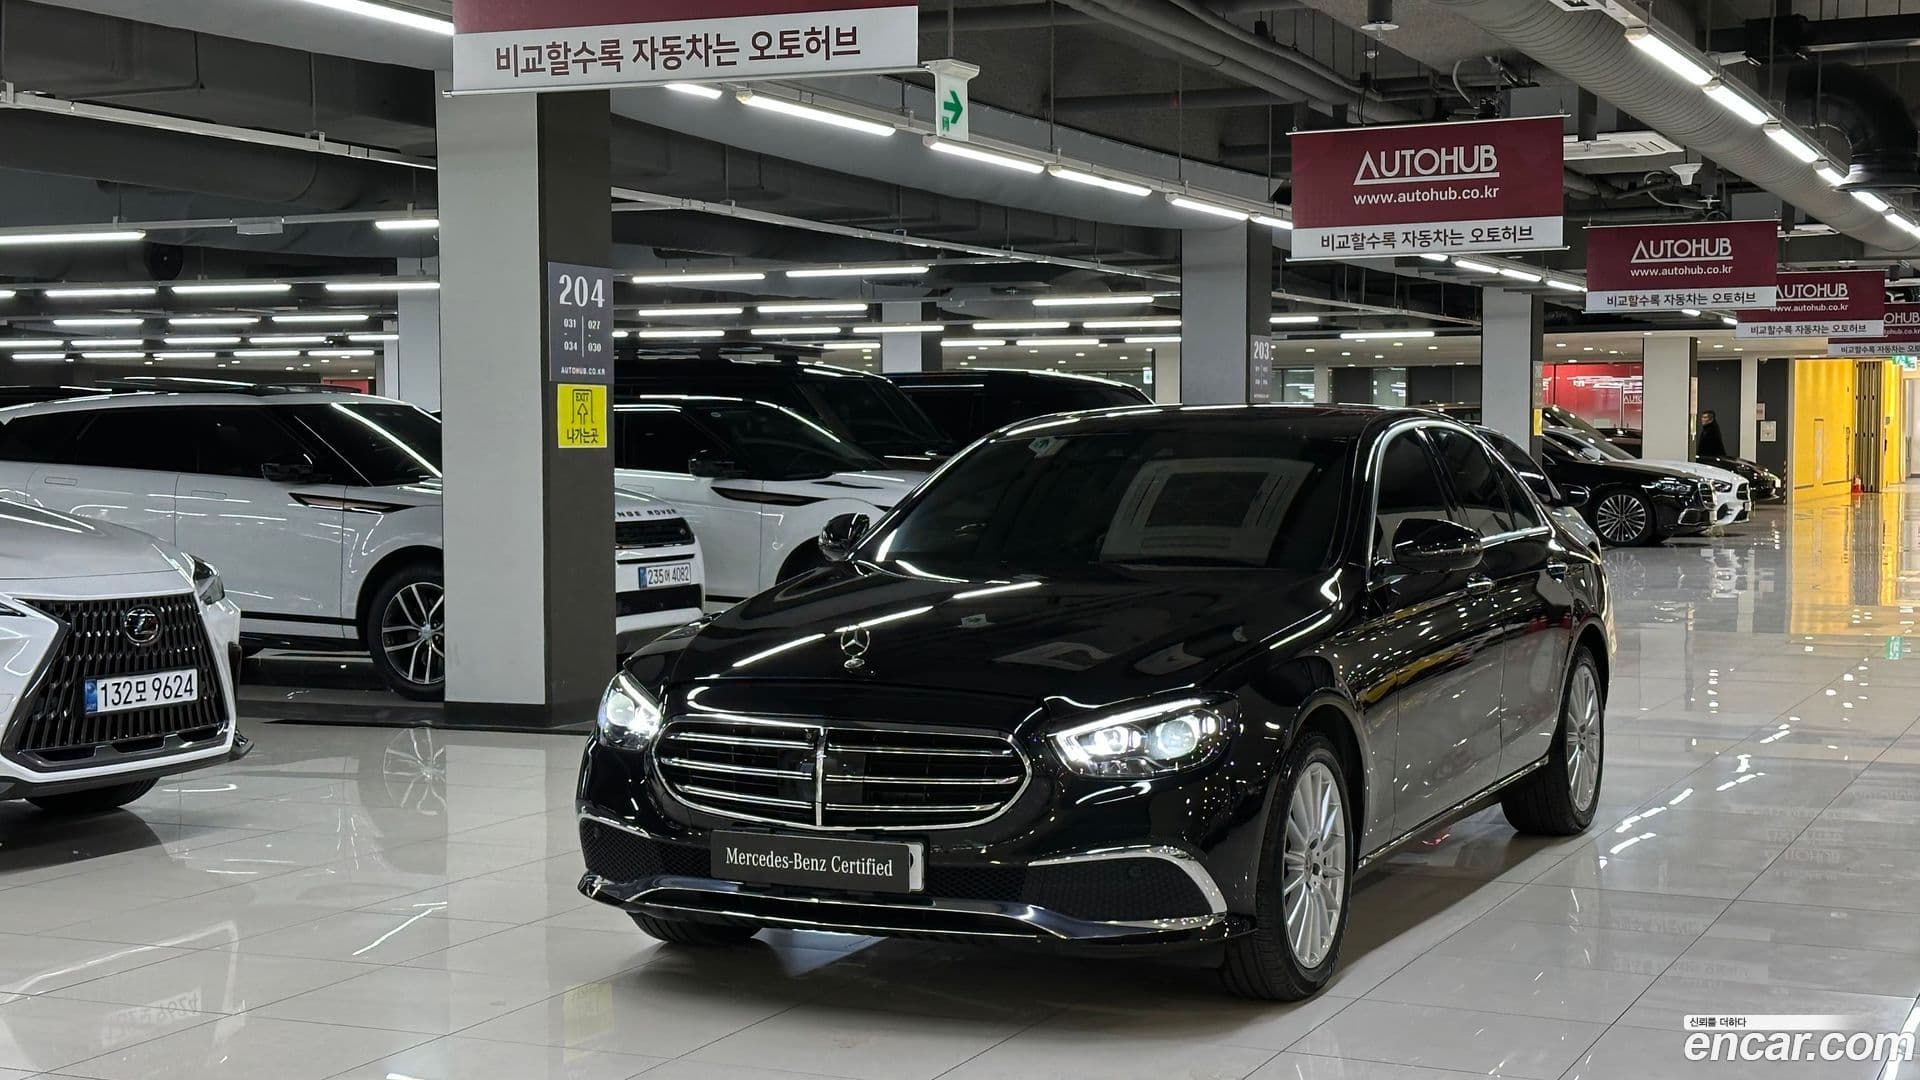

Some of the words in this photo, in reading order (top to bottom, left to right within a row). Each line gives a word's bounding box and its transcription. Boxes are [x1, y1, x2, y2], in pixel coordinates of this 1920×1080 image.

[495, 38, 624, 78] 비교할수록
[632, 32, 740, 71] 자동차는
[748, 25, 861, 62] 오토허브
[1353, 144, 1500, 186] AUTOHUB
[1353, 185, 1500, 206] www.autohub.co.kr
[1321, 231, 1397, 251] 비교할수록
[1402, 228, 1464, 248] 자동차는
[1469, 225, 1534, 244] 오토허브
[1630, 237, 1734, 263] AUTOHUB
[1630, 264, 1733, 277] www.autohub.co.kr
[559, 274, 606, 308] 204
[1607, 294, 1660, 308] 비교할수록
[1664, 293, 1708, 306] 자동차는
[1712, 292, 1757, 304] 오토허브
[564, 318, 577, 328] 031
[1883, 312, 1920, 325] OHUB
[1750, 325, 1792, 336] 비교할수록
[1795, 324, 1829, 335] 자동차는
[1831, 324, 1867, 333] 오토허브
[564, 341, 578, 351] 034
[588, 343, 602, 352] 030
[1254, 341, 1270, 360] 203
[575, 392, 590, 402] EXIT
[566, 427, 599, 443] 나가는곳
[672, 566, 689, 582] 4082
[101, 680, 147, 708] 132모
[152, 673, 194, 701] 9624
[726, 847, 827, 872] Mercedes-Benz
[831, 855, 893, 877] Certified
